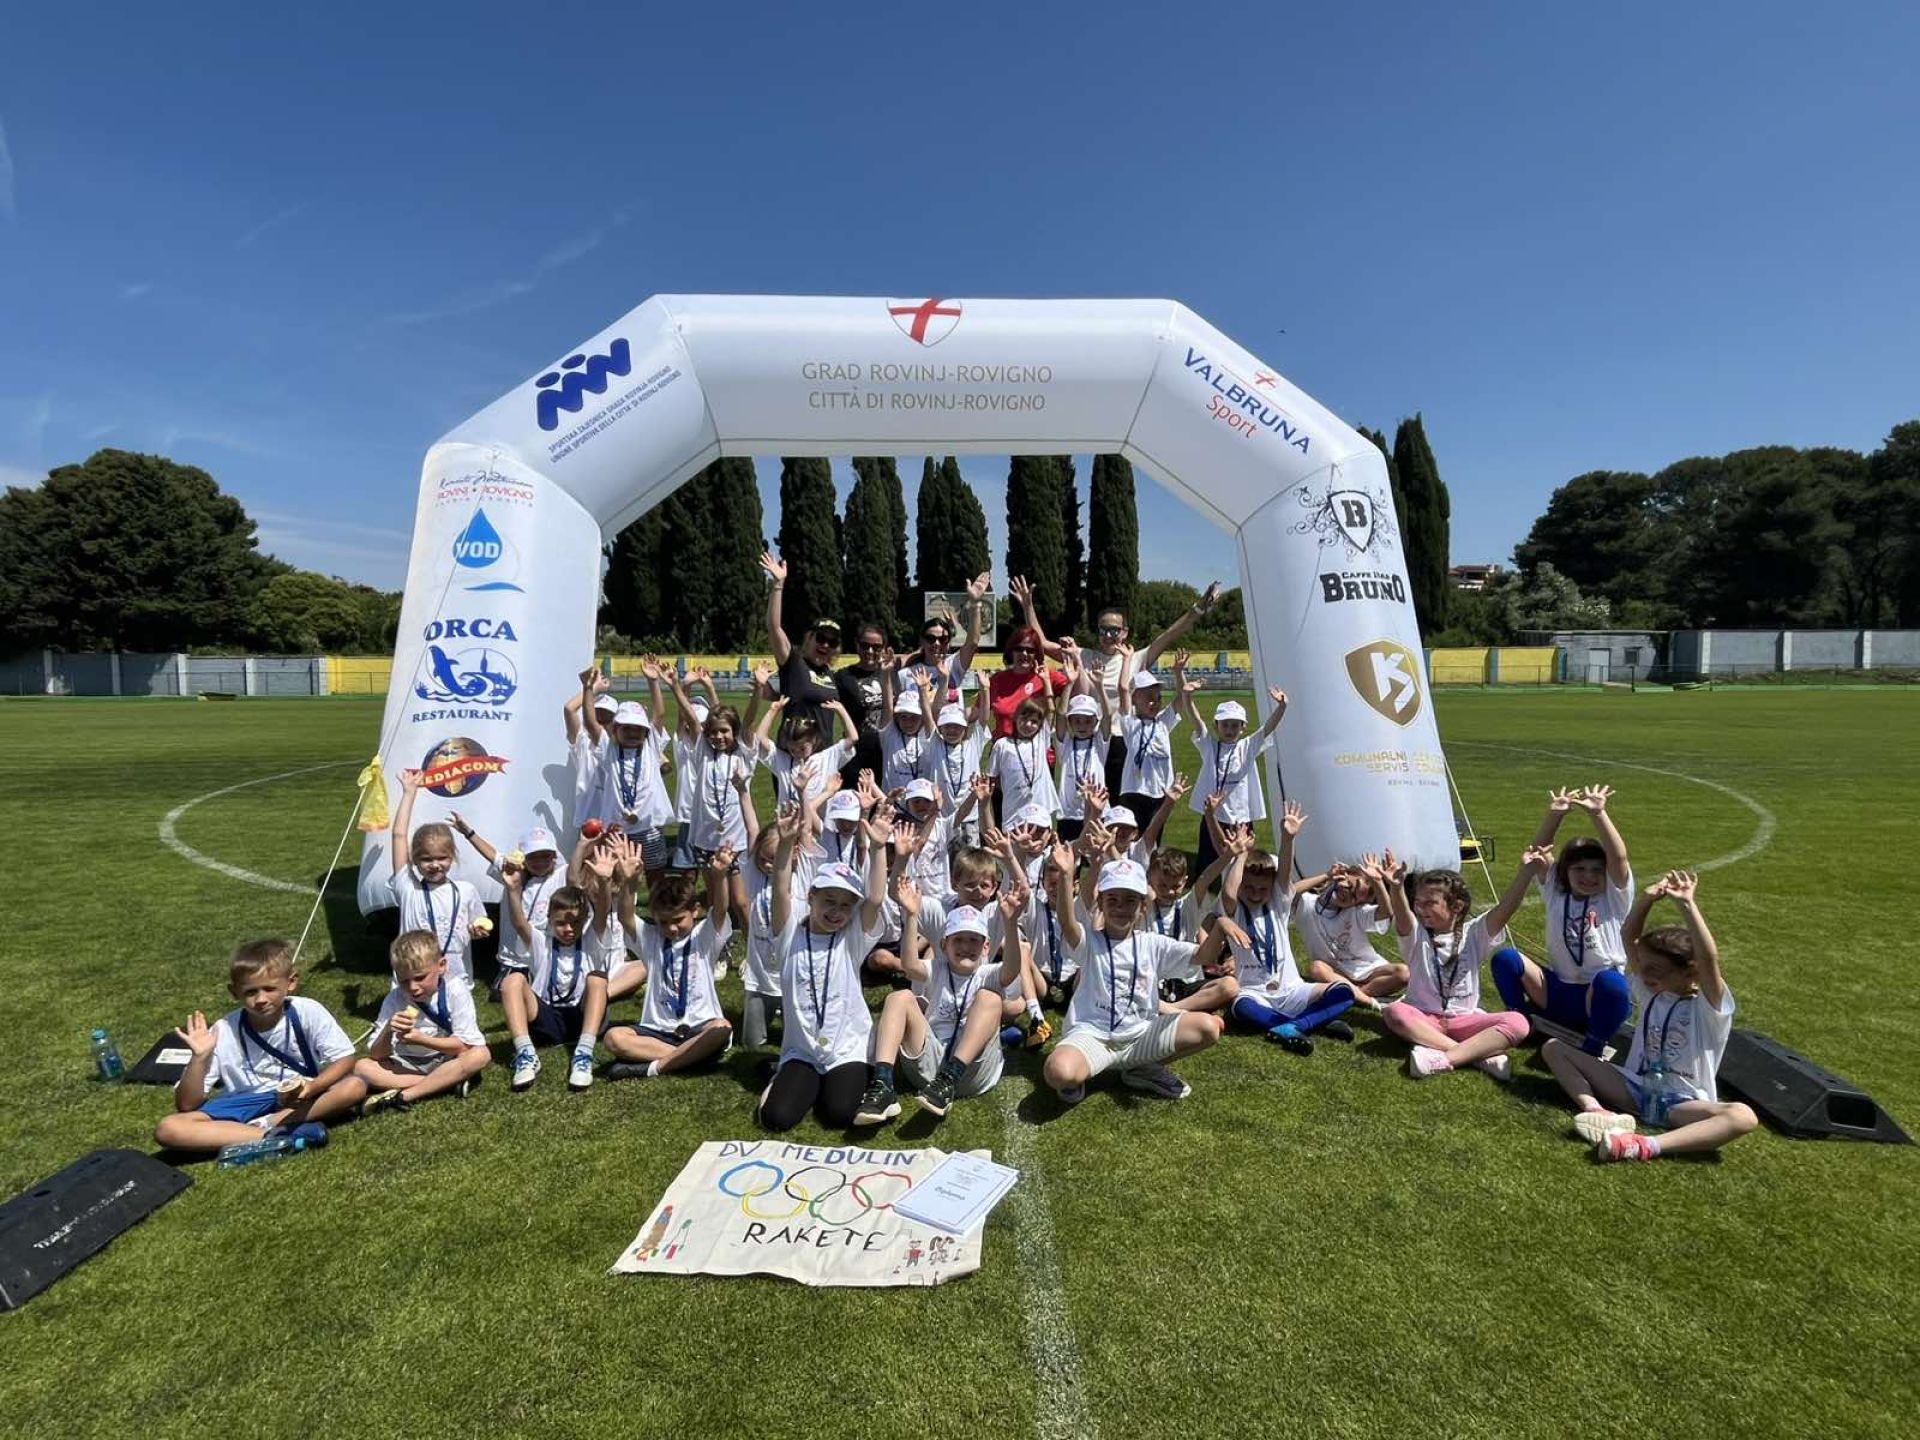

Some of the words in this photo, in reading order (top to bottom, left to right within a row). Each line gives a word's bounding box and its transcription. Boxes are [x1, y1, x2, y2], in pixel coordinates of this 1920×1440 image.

[802, 362, 861, 381] GRAD
[870, 364, 1052, 383] ROVINJ-ROVIGNO
[808, 386, 861, 408] CITTÀ
[866, 393, 883, 408] DI
[892, 393, 1045, 411] ROVINJ-ROVIGNO
[1184, 347, 1311, 454] VALBRUNA
[1206, 394, 1257, 438] Sport
[1319, 572, 1406, 604] BRUNO
[424, 618, 518, 642] ORCA
[412, 709, 512, 723] RESTAURANT
[719, 1142, 762, 1157] DV
[781, 1144, 916, 1166] MEDULIN
[742, 1222, 886, 1252] RAKETE
